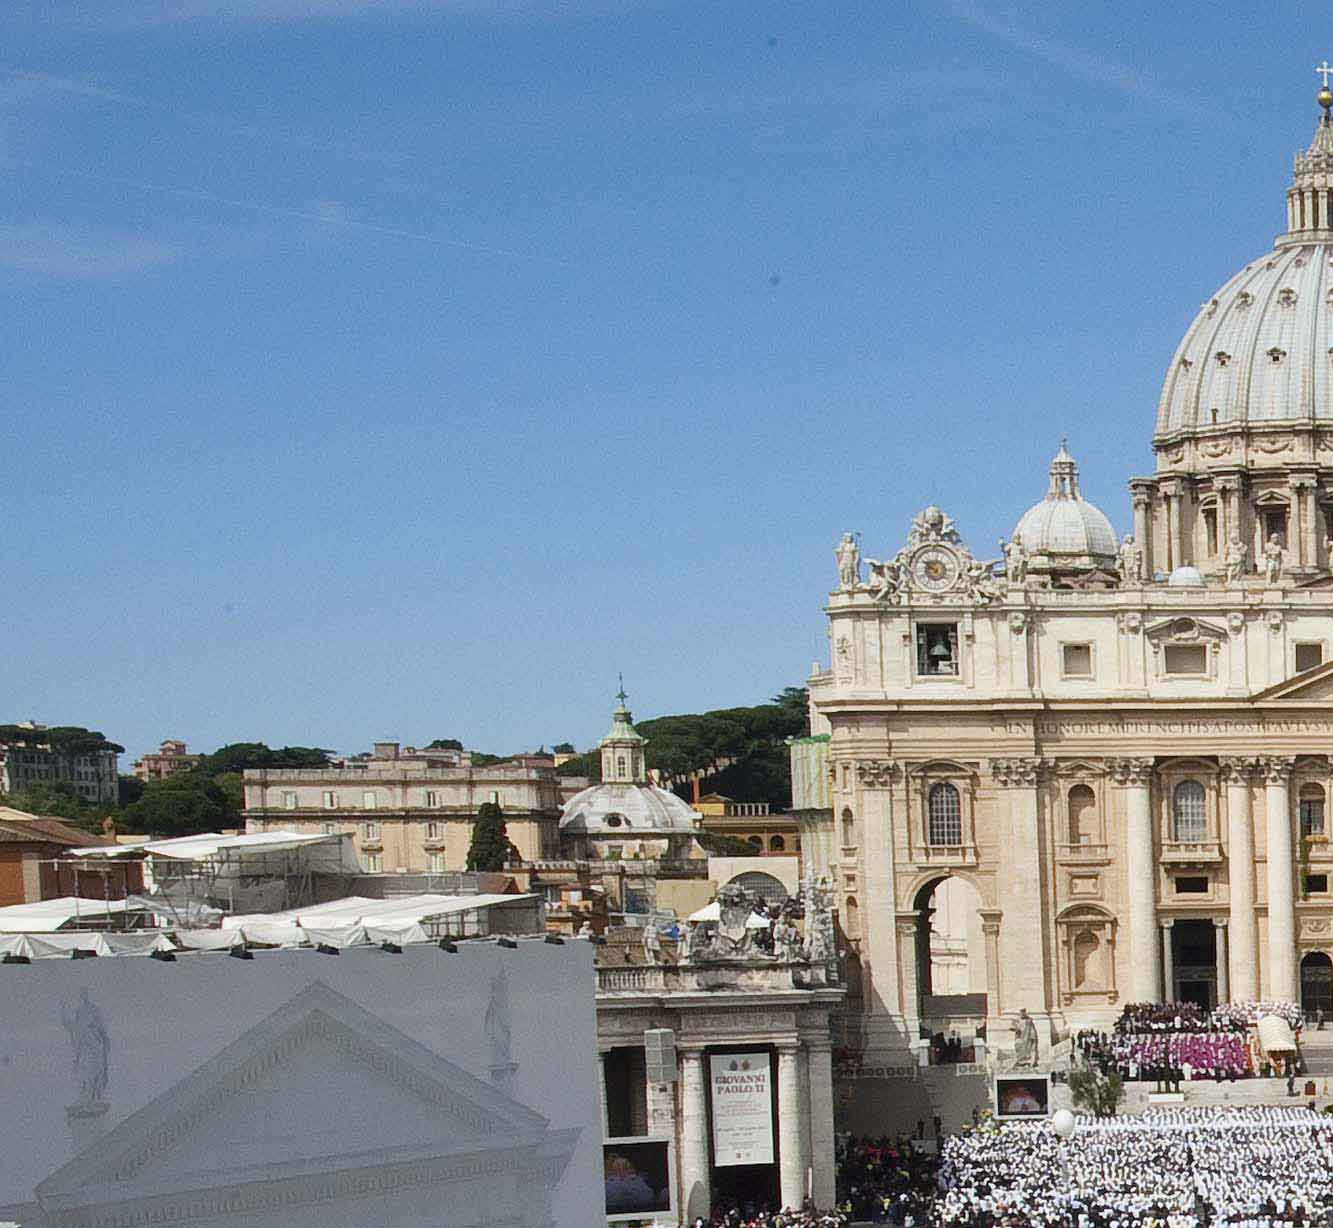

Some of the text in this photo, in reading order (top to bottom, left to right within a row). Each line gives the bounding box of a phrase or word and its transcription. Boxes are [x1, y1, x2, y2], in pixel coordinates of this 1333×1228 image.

[1008, 722, 1027, 734] IN
[1039, 721, 1122, 734] HONOREM
[1125, 720, 1209, 733] PRINCIPIS
[715, 1074, 765, 1084] GIOVANNI
[717, 1086, 753, 1095] PAOLO
